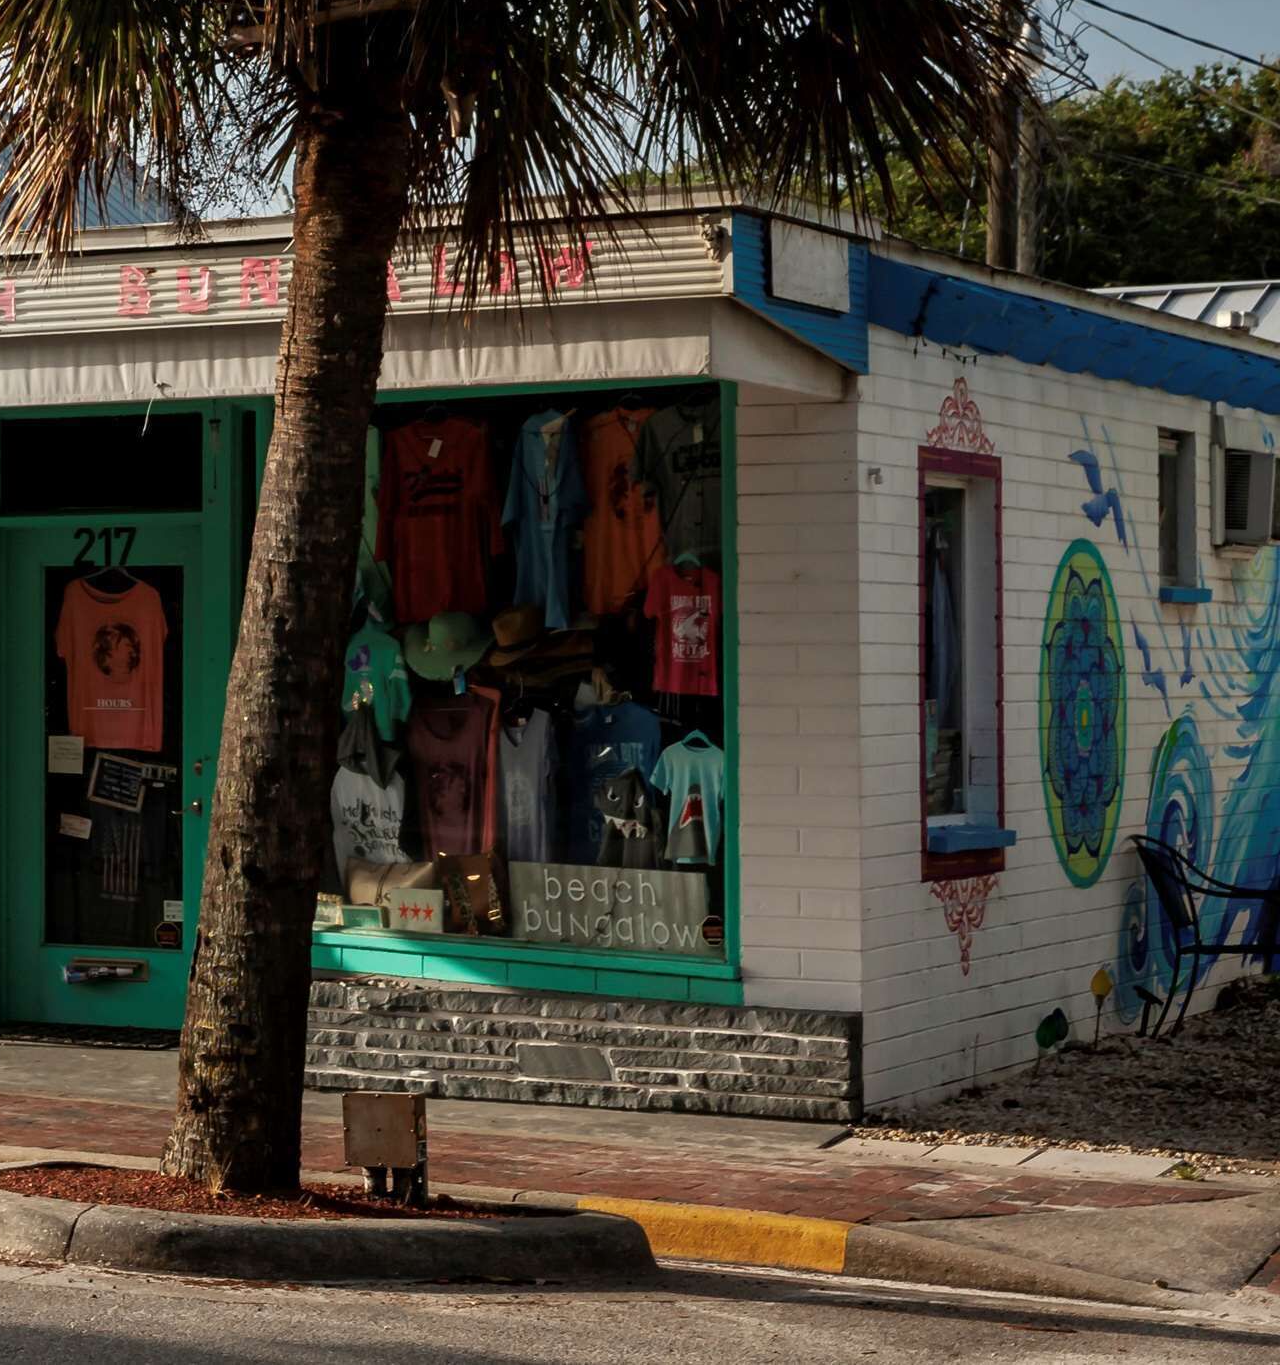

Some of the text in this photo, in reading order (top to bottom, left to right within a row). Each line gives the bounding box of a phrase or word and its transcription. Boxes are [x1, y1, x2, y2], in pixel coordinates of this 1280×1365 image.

[117, 240, 595, 317] BUNLOW
[73, 527, 137, 568] 217
[96, 697, 133, 709] HOURS
[543, 868, 657, 908] beach
